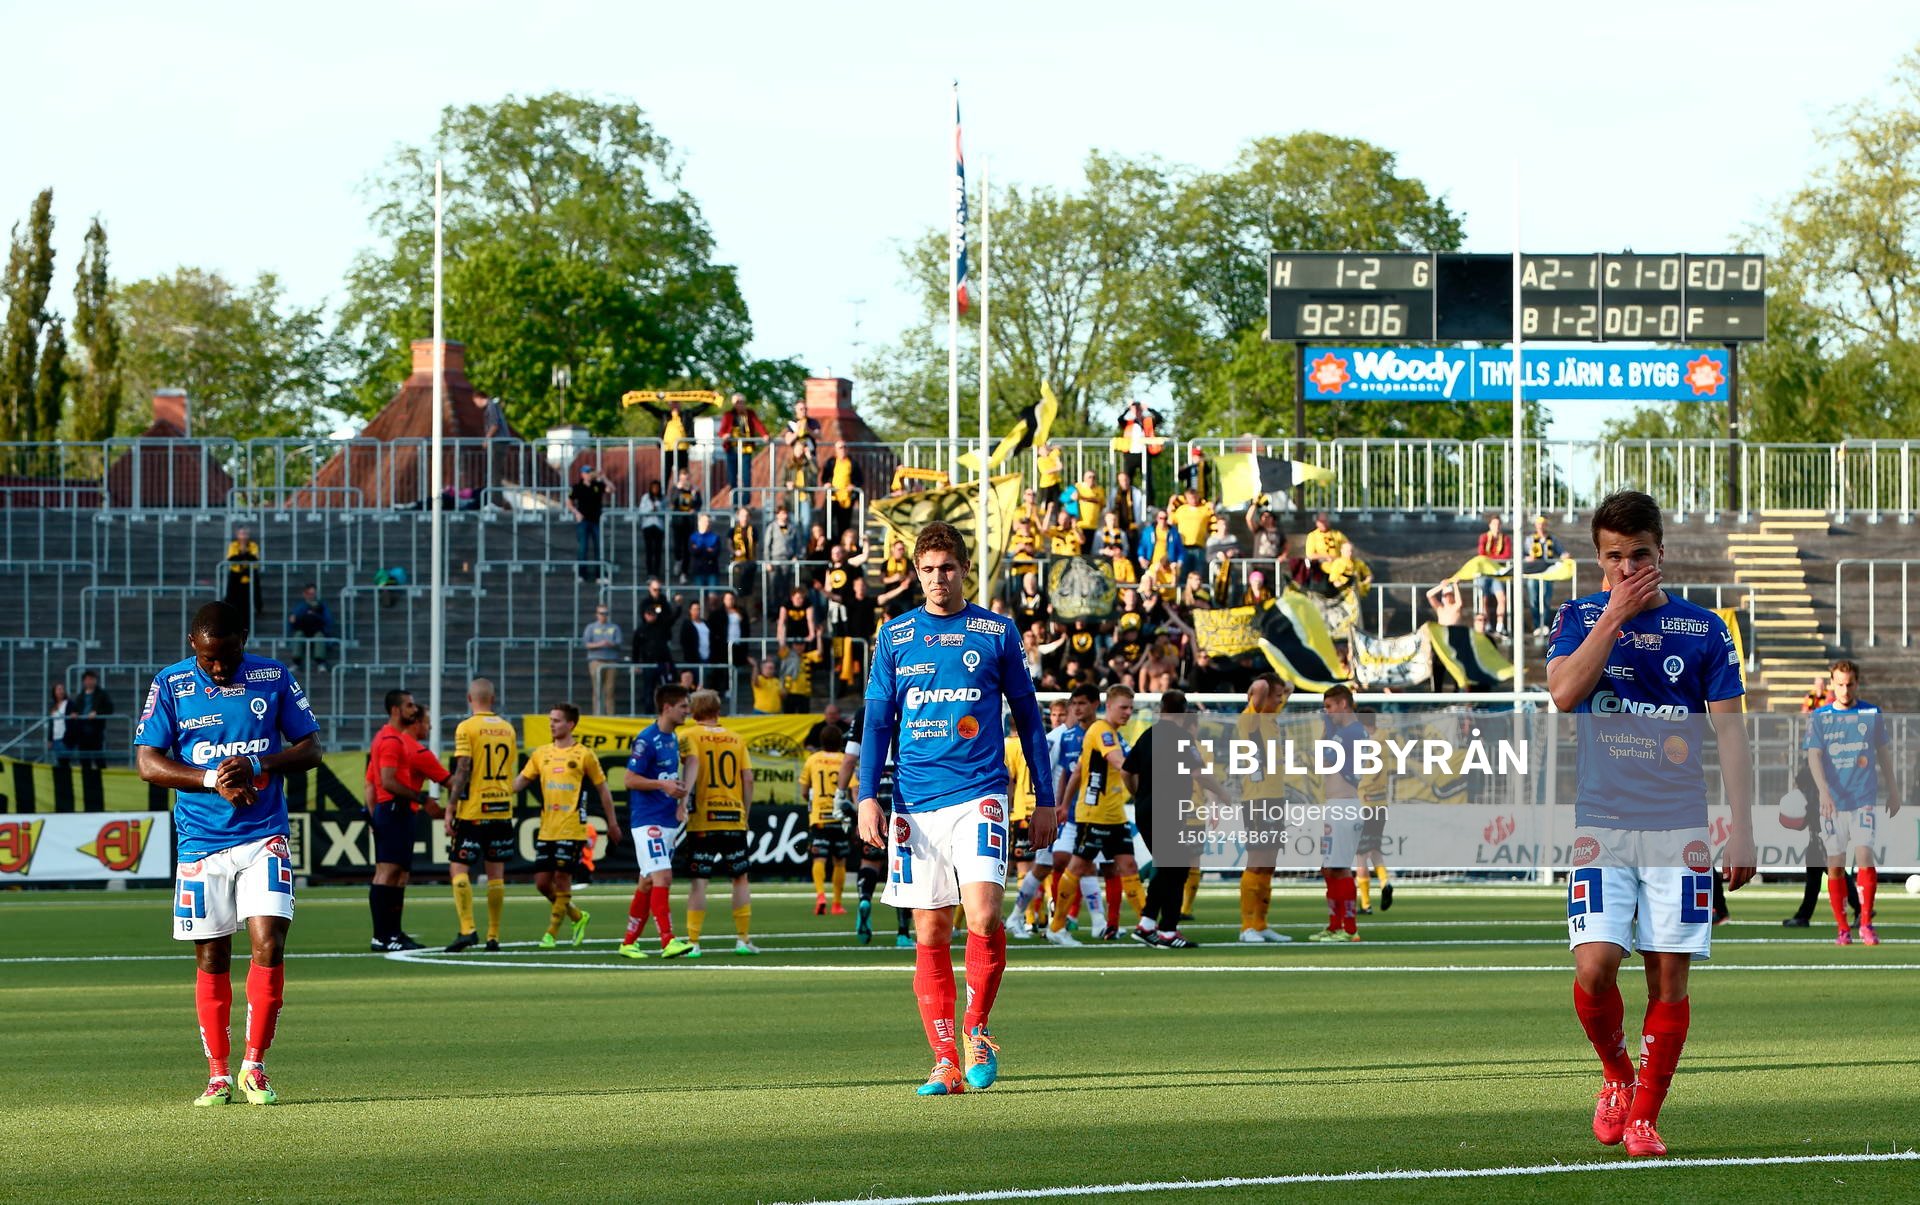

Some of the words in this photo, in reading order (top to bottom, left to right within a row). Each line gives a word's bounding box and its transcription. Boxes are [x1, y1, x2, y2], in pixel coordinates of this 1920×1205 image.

[1274, 260, 1292, 287] H
[1336, 258, 1380, 290] 1-2
[1412, 261, 1429, 287] G
[1302, 304, 1401, 336] 92:06
[1353, 350, 1466, 398] Woody
[1554, 357, 1604, 387] JÄRN
[1608, 364, 1624, 387] &
[1628, 362, 1679, 387] BYGG
[966, 620, 1006, 634] LEGENDS
[1661, 620, 1709, 633] LEGENDS
[1635, 640, 1662, 650] SPORT
[245, 670, 281, 680] LEGENDS
[896, 662, 935, 674] MINEC
[906, 686, 981, 709] CONRAD
[1592, 690, 1689, 721] CONRAD
[179, 714, 222, 728] MINEC
[911, 729, 948, 740] Sparbank
[1596, 730, 1657, 748] Åtvidabergs
[192, 738, 270, 765] CONRAD
[1609, 746, 1656, 759] Sparbank
[483, 744, 510, 780] 12
[706, 750, 736, 788] 10
[1688, 850, 1709, 862] mix
[180, 920, 193, 931] 19
[1572, 916, 1586, 932] 14
